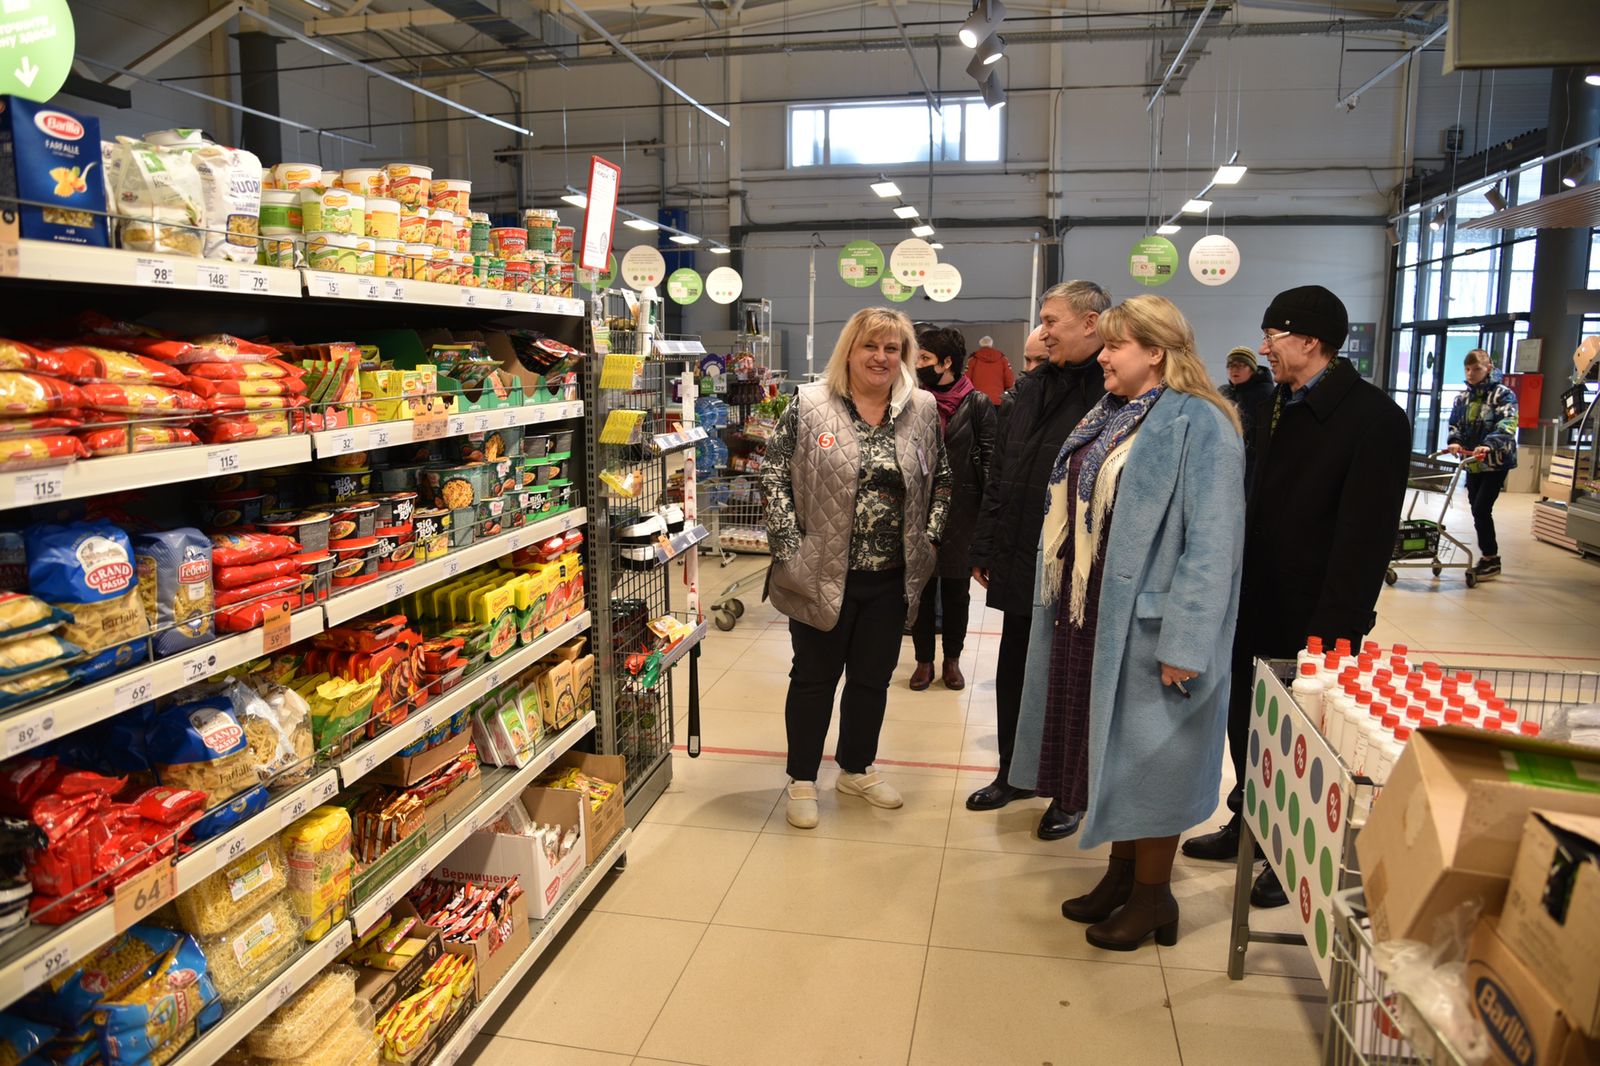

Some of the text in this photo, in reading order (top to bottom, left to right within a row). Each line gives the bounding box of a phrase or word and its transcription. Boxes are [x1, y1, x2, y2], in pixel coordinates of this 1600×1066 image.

[47, 117, 81, 136] Barilla
[45, 140, 80, 155] FARFALLE
[154, 268, 168, 281] 98
[208, 273, 225, 286] 148
[253, 277, 264, 288] 79
[220, 456, 234, 469] 115
[34, 481, 54, 497] 115
[416, 518, 432, 529] BIG
[419, 524, 436, 538] BON
[88, 564, 130, 584] GRAND
[102, 578, 126, 591] PASTA
[192, 662, 203, 675] 79
[132, 685, 146, 700] 69
[18, 727, 34, 742] 89
[324, 783, 333, 796] 49
[292, 802, 302, 815] 49
[229, 840, 241, 855] 69
[134, 878, 161, 911] 64
[45, 952, 62, 969] 99
[1479, 984, 1532, 1064] Barilla
